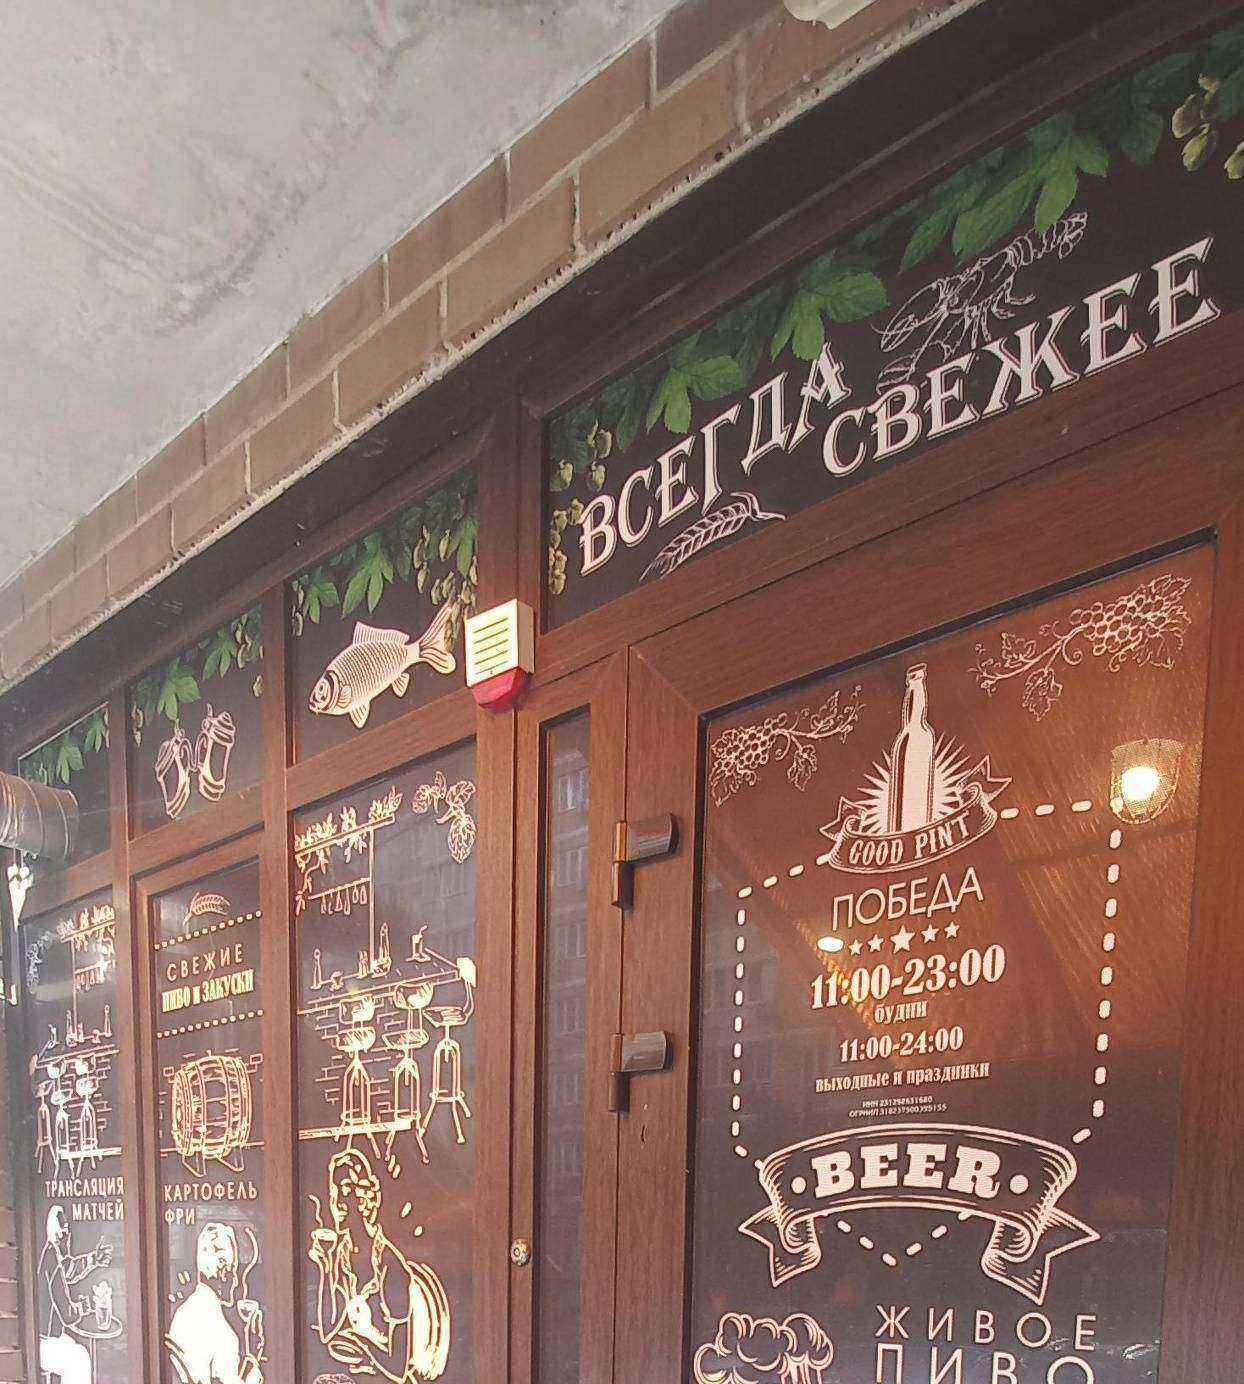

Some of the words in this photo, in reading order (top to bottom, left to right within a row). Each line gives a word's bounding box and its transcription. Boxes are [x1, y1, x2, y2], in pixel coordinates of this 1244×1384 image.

[821, 236, 1223, 478] СВЕЖЕЕ
[577, 342, 854, 578] ВСЕГДА
[849, 832, 903, 867] GOOD
[915, 812, 973, 861] PINT
[832, 867, 984, 930] ПОБЕДА
[166, 943, 243, 981] СВЕЖИЕ
[810, 944, 1006, 1010] 11:00-23:00
[162, 985, 191, 1013] ПИВО
[202, 968, 254, 1003] ЗАКУСКИ
[874, 1001, 927, 1024] будни
[840, 1027, 963, 1063] 11:00-24:00
[815, 1072, 889, 1093] выходные
[893, 1070, 903, 1086] и
[906, 1062, 991, 1086] праздники
[45, 1176, 125, 1198] ТРАНСЛЯЦИЯ
[811, 1143, 1001, 1199] BEER
[72, 1199, 125, 1221] МАТЧЕЙ
[164, 1182, 258, 1203] КАРТОФЕЛЬ
[164, 1206, 195, 1225] ФРИ
[875, 1305, 1097, 1351] ЖИВОЕ
